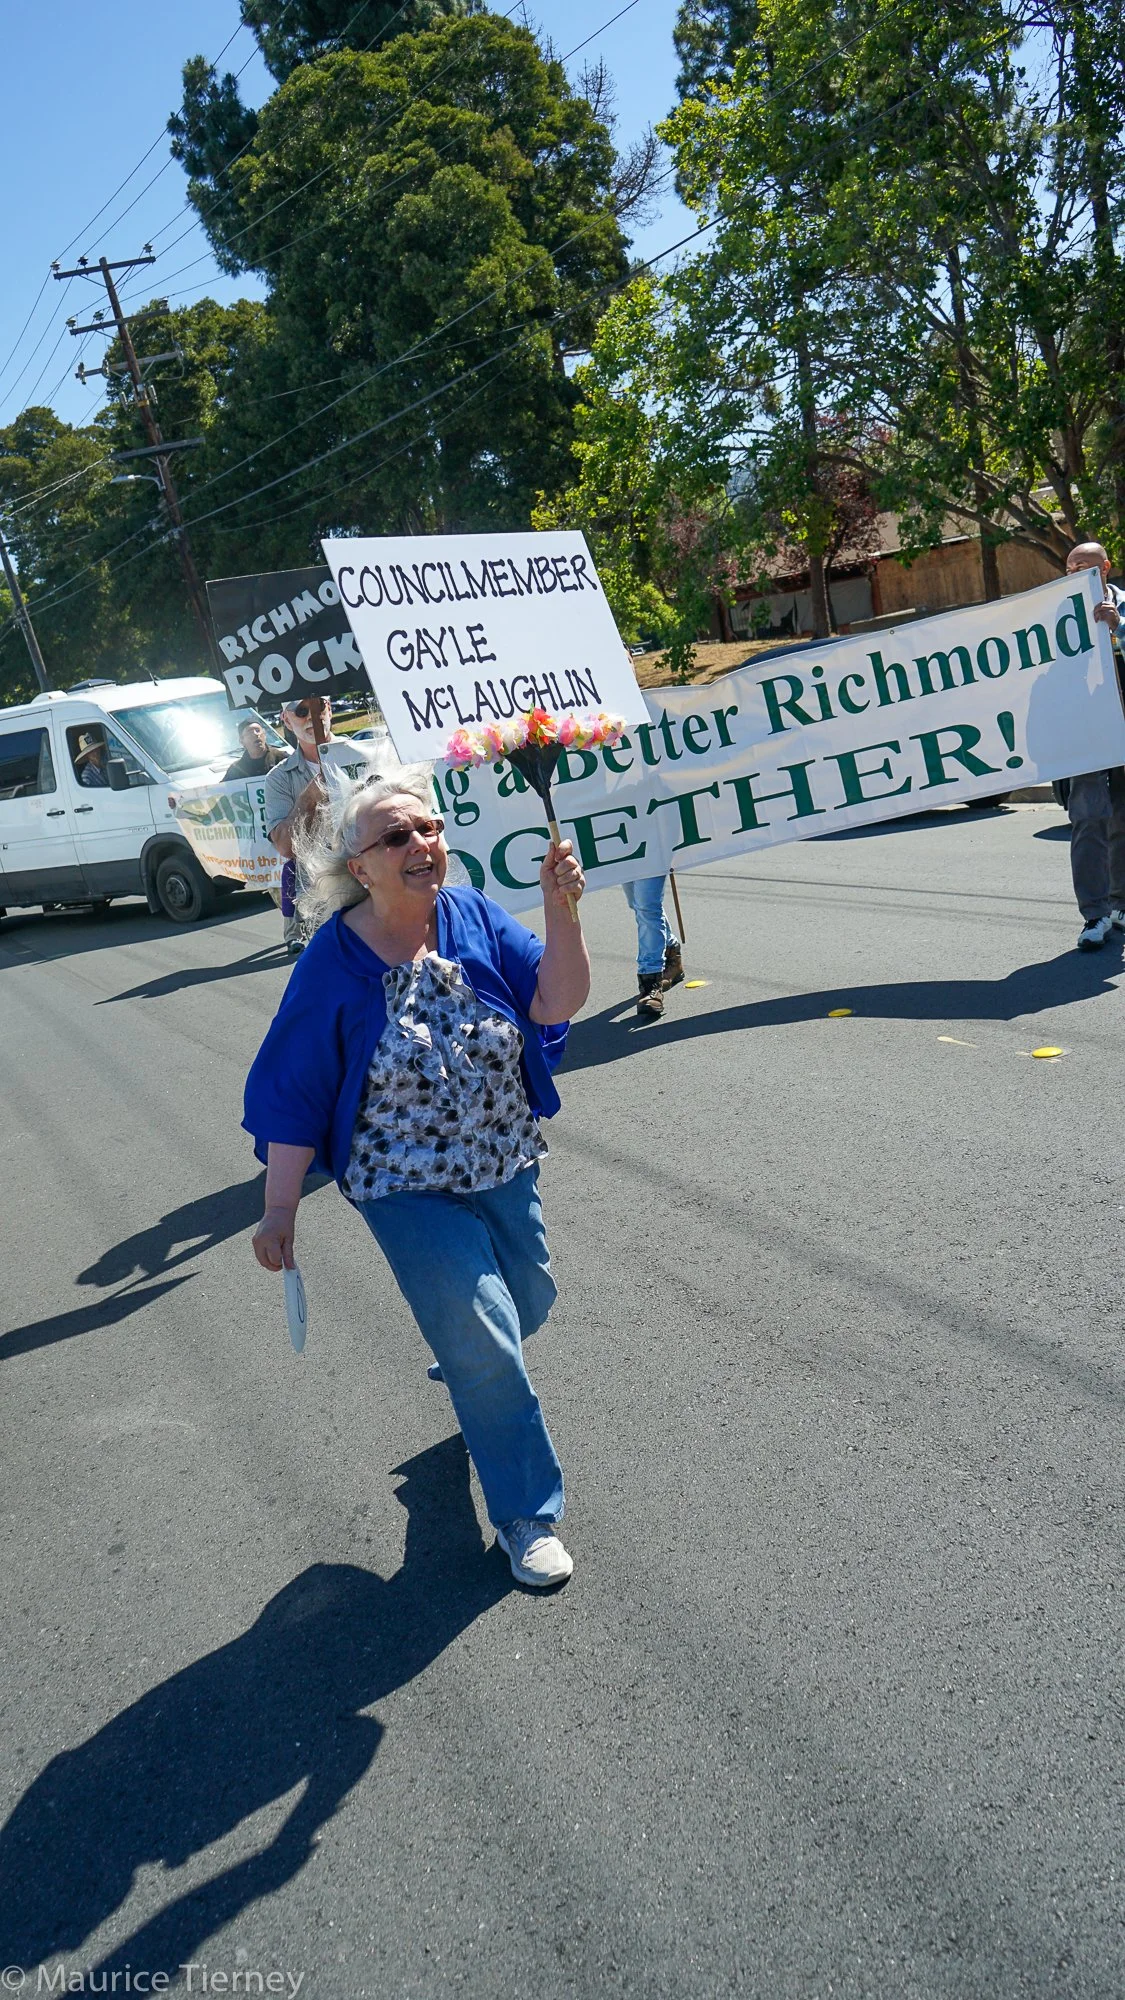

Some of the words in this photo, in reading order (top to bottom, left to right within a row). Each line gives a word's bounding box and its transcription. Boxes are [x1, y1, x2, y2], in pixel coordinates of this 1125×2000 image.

[338, 554, 598, 608] COUNCILMEMBER
[218, 580, 341, 663] RICHMO
[386, 623, 497, 671] GAYLE
[553, 705, 738, 786] Better
[755, 592, 1096, 736] Richmond
[447, 710, 1024, 891] GETHER!
[257, 855, 277, 867] the
